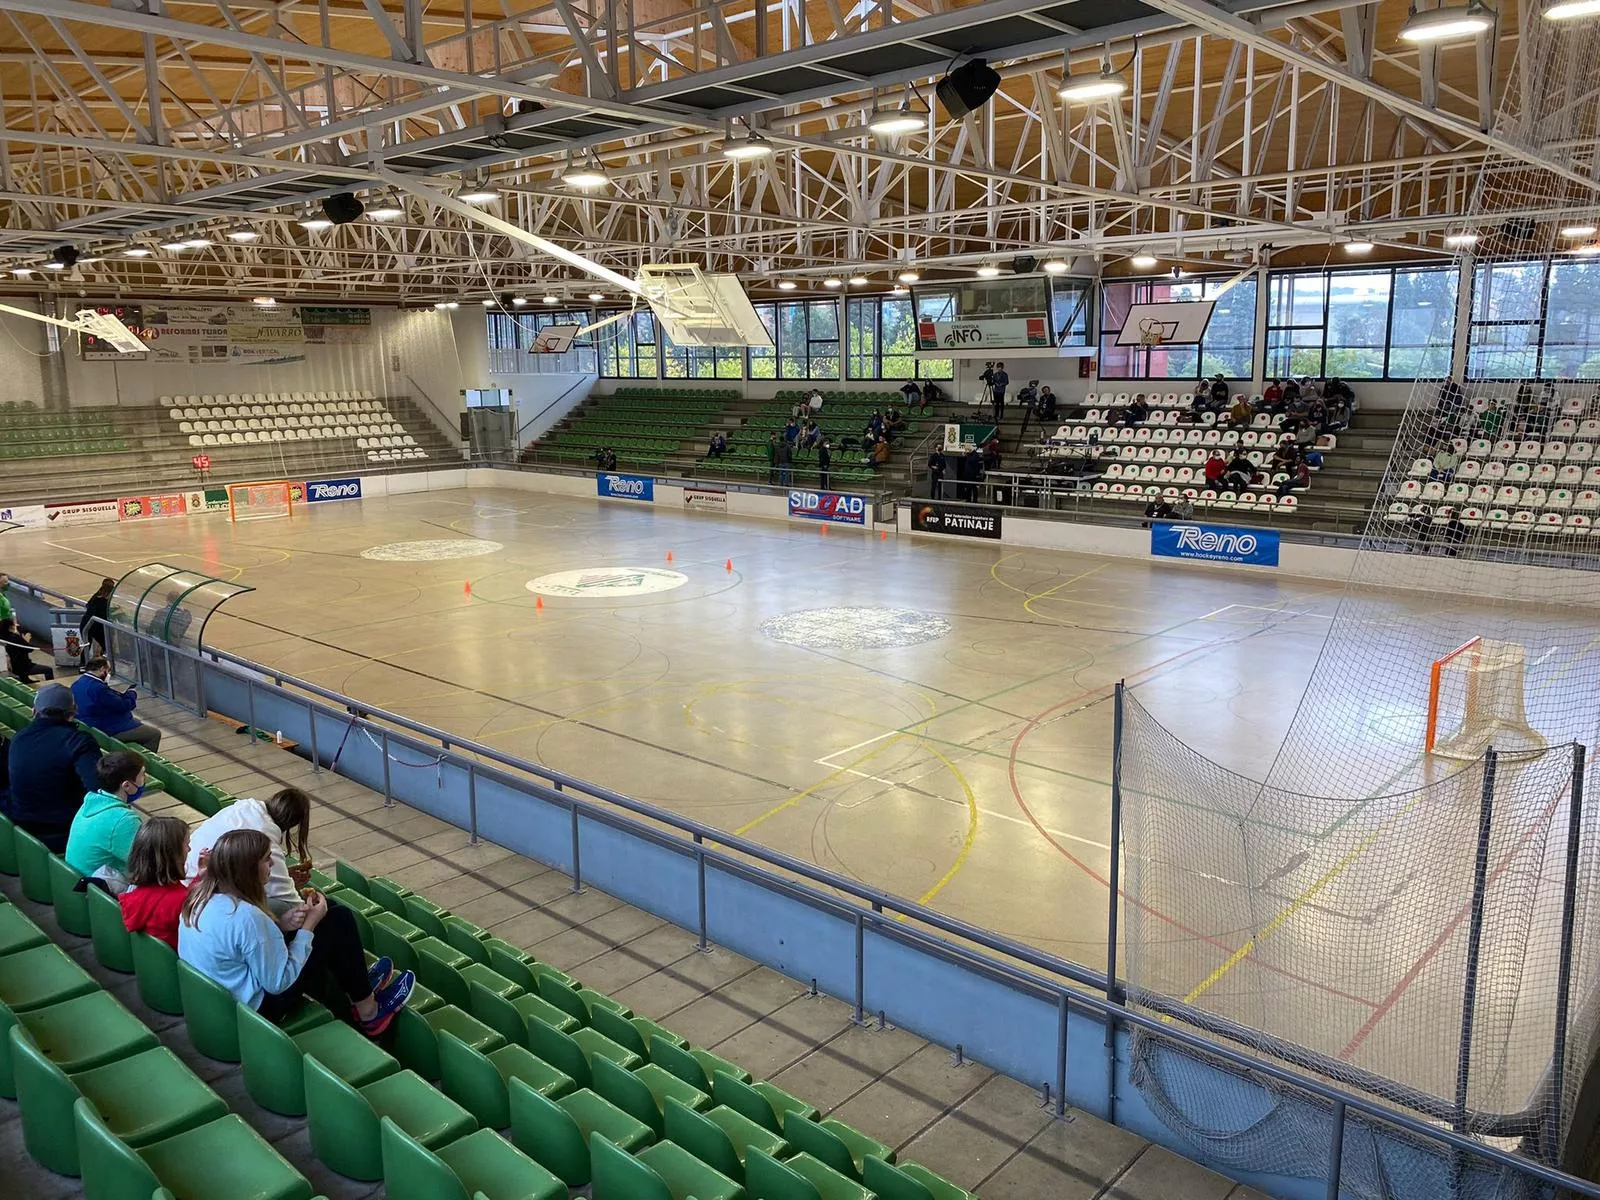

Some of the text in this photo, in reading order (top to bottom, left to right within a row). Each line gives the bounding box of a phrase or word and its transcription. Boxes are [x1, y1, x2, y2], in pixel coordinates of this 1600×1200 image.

[161, 328, 200, 336] REFORMAS
[257, 328, 302, 338] NAVARRO
[952, 329, 982, 343] INFO
[193, 456, 209, 468] 45
[309, 483, 359, 498] Reno
[605, 475, 644, 494] Reno
[82, 505, 117, 513] SISQUELLA
[832, 514, 861, 522] SOFTWARE
[944, 517, 994, 531] PATINAJE
[1168, 525, 1257, 554] Reno
[1180, 551, 1243, 562] www.hockeyreno.com
